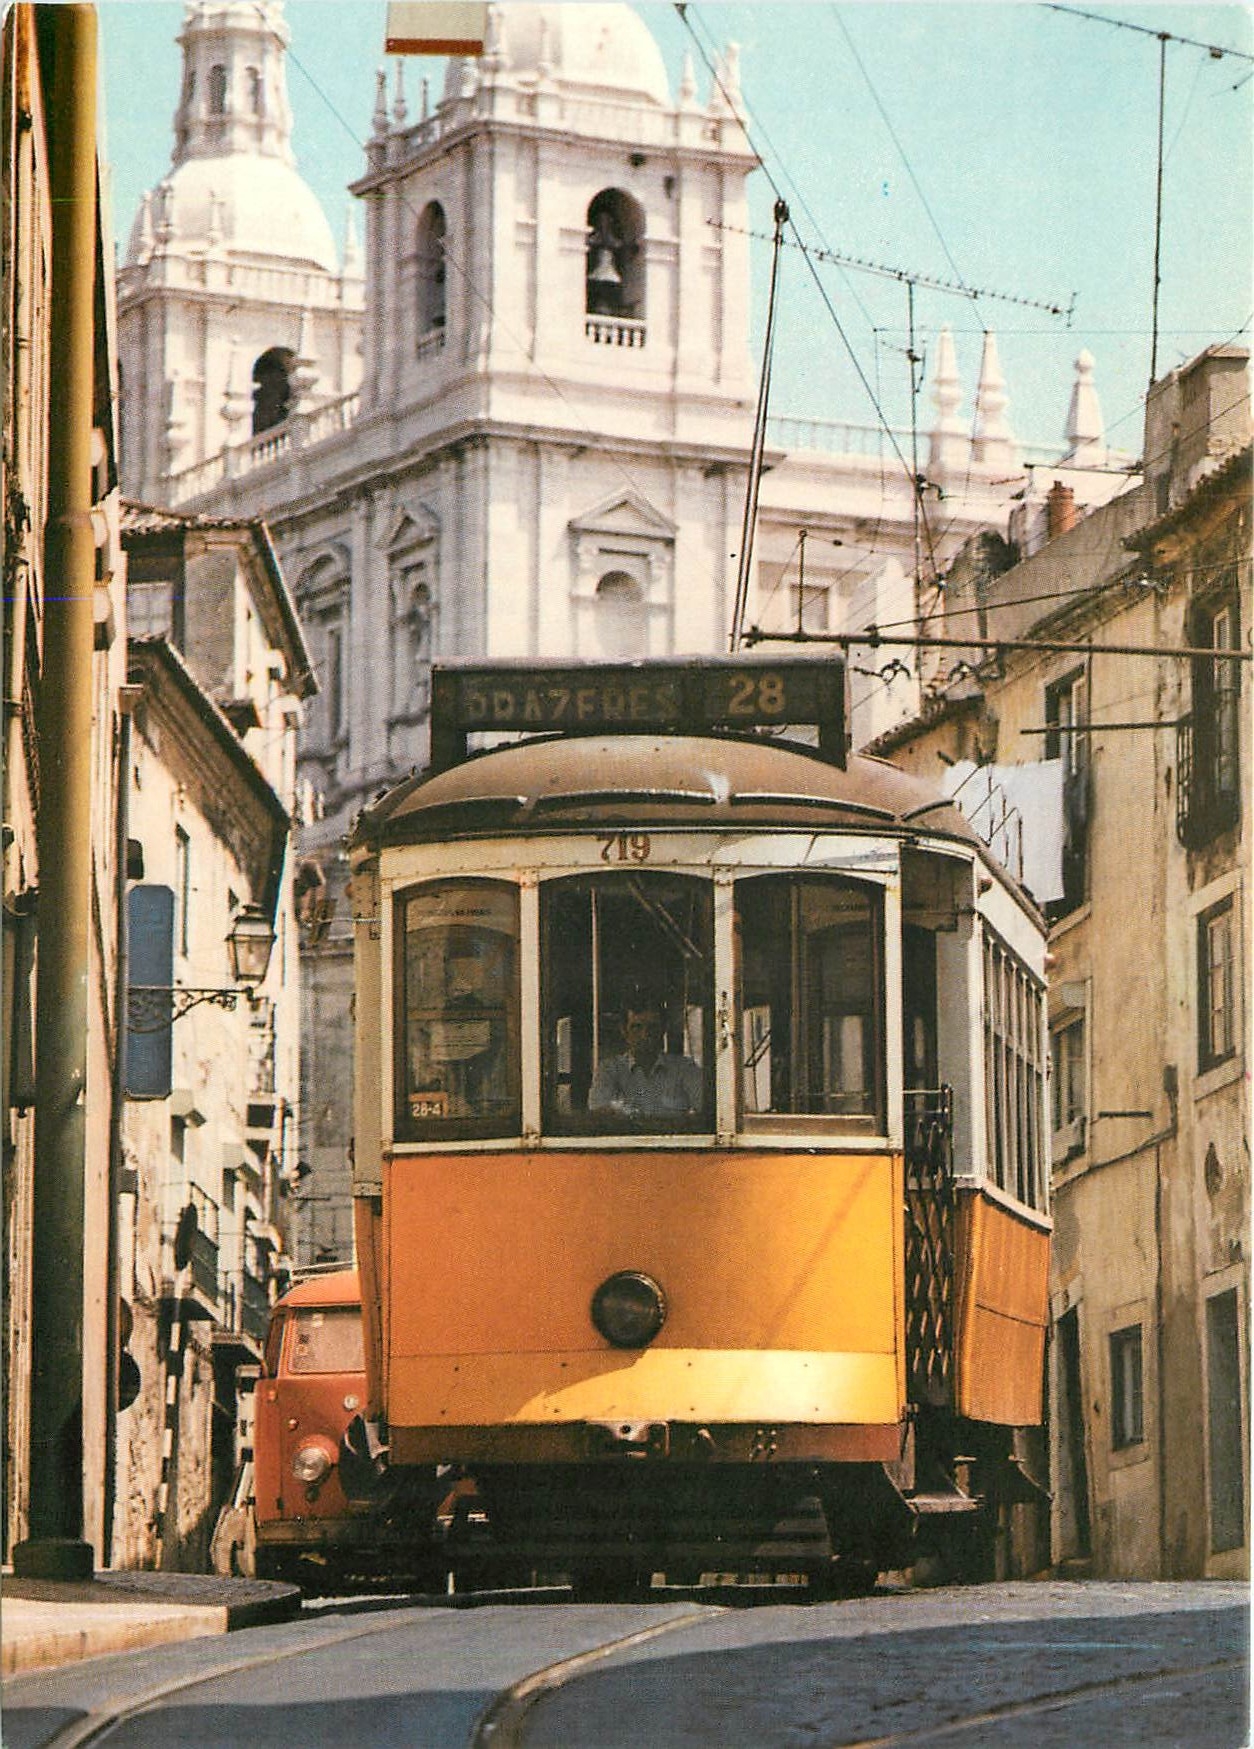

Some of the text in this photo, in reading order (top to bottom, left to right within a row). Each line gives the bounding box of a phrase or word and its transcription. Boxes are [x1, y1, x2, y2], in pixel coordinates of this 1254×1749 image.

[728, 673, 785, 715] 28
[598, 833, 650, 861] 719
[412, 1102, 441, 1117] 28-4
